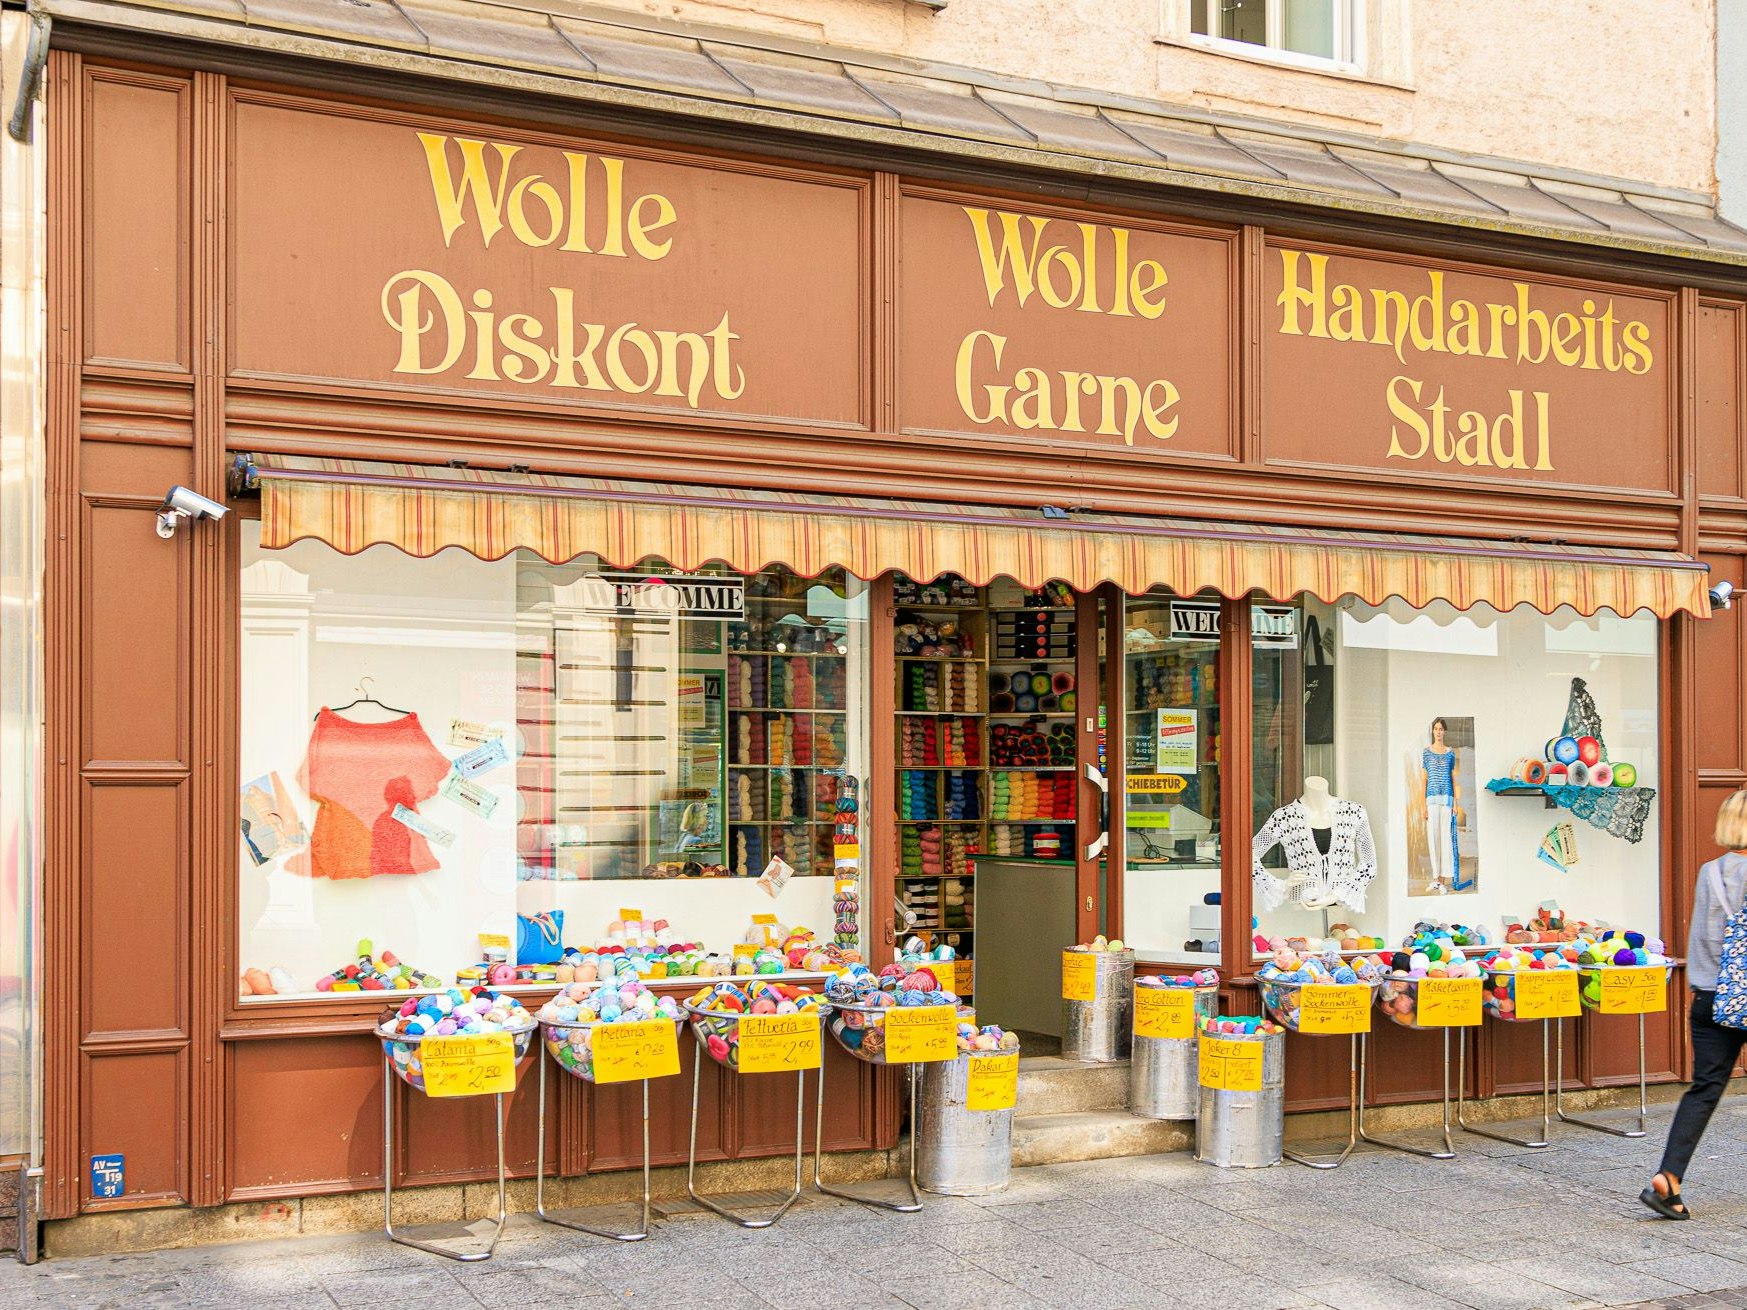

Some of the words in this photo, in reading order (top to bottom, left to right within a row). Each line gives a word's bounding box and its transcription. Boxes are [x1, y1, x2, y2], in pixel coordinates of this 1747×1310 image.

[415, 132, 677, 261] Wolle
[961, 206, 1169, 320] Wolle
[1276, 249, 1653, 375] Handarbeits
[380, 269, 746, 409] Diskont
[955, 330, 1181, 447] Garne
[1385, 375, 1555, 471] Stadl
[1162, 715, 1192, 724] SOMMER
[1603, 971, 1636, 990] Easy
[1152, 993, 1184, 1005] Cotton
[888, 1009, 951, 1024] Sockenwolle
[1204, 1040, 1230, 1055] Joker
[1232, 1043, 1242, 1056] 8
[972, 1059, 1003, 1073] Dakar
[93, 1160, 106, 1170] AV
[104, 1185, 116, 1196] 31
